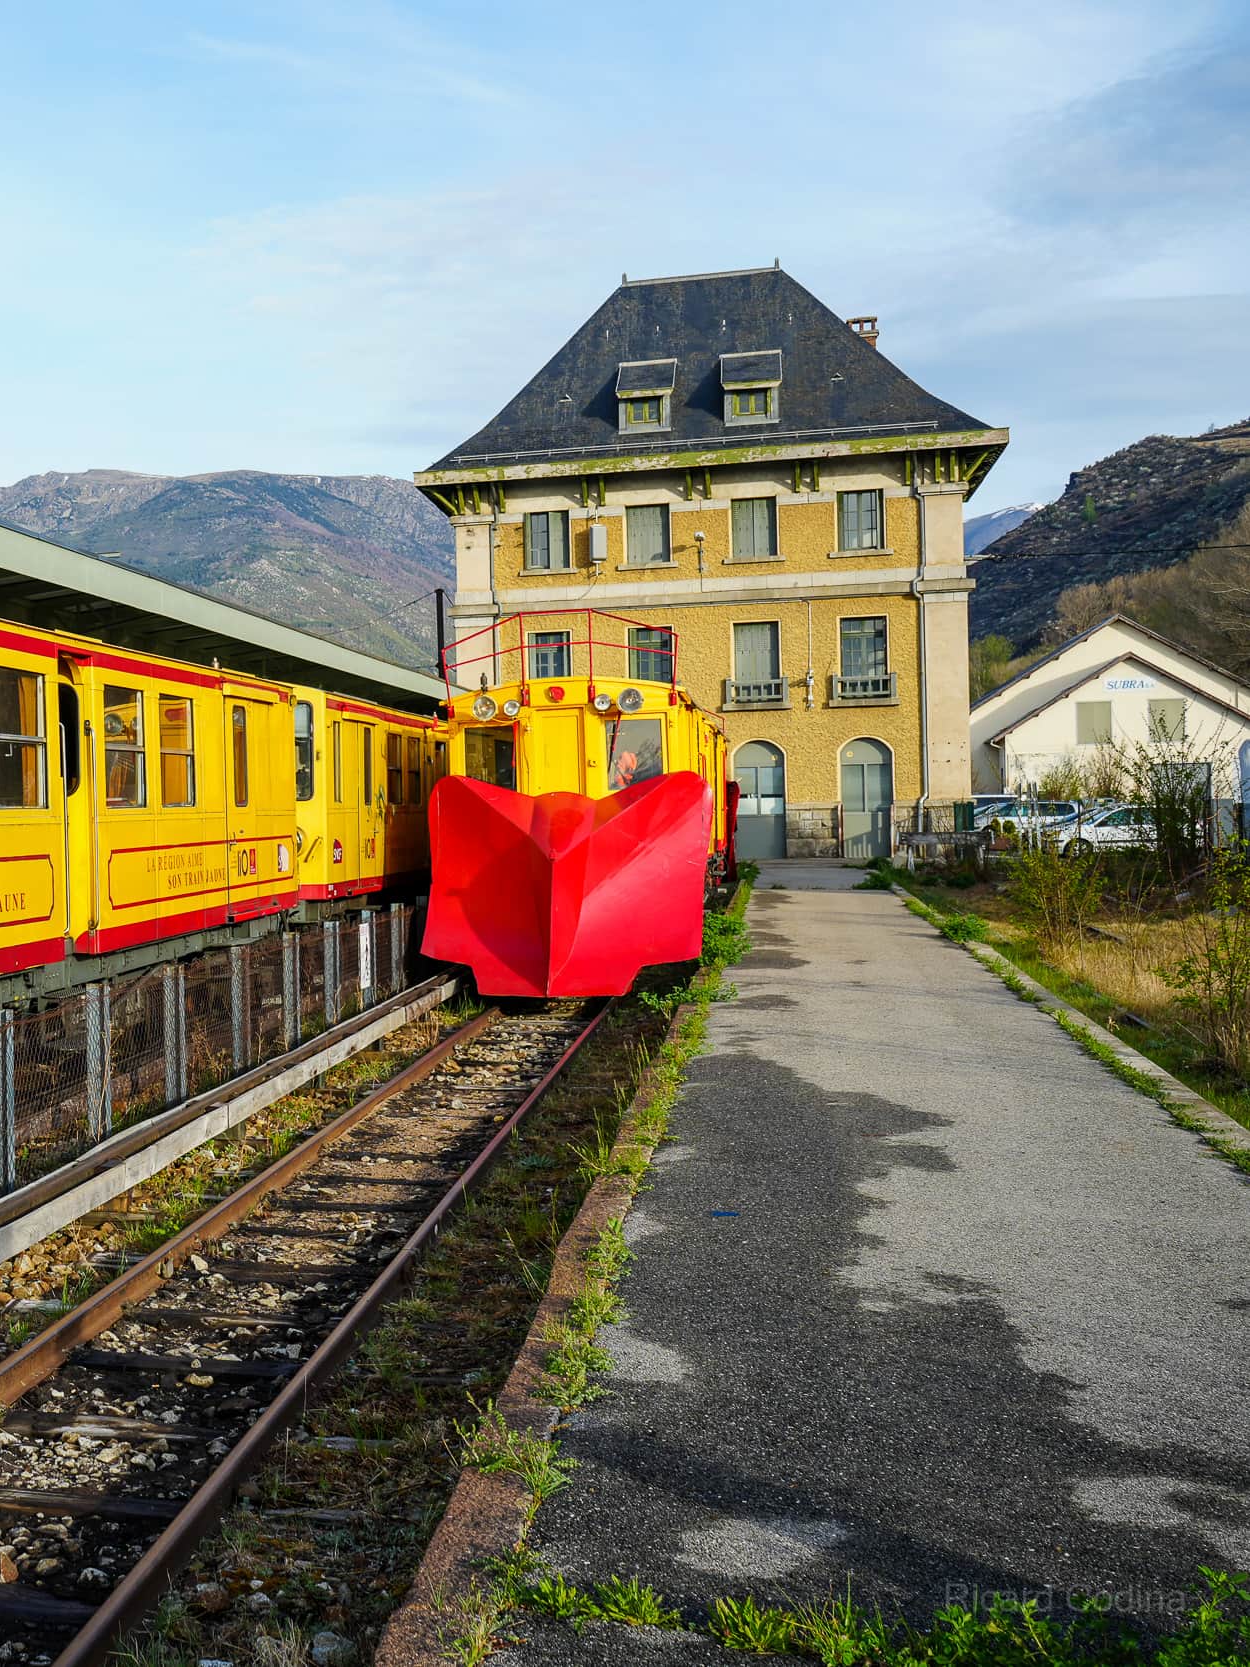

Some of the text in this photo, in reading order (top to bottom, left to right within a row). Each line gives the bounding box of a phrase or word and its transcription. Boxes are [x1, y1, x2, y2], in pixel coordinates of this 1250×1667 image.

[1107, 679, 1144, 690] SUBRA
[168, 868, 226, 890] SON TRAIN JAUNE
